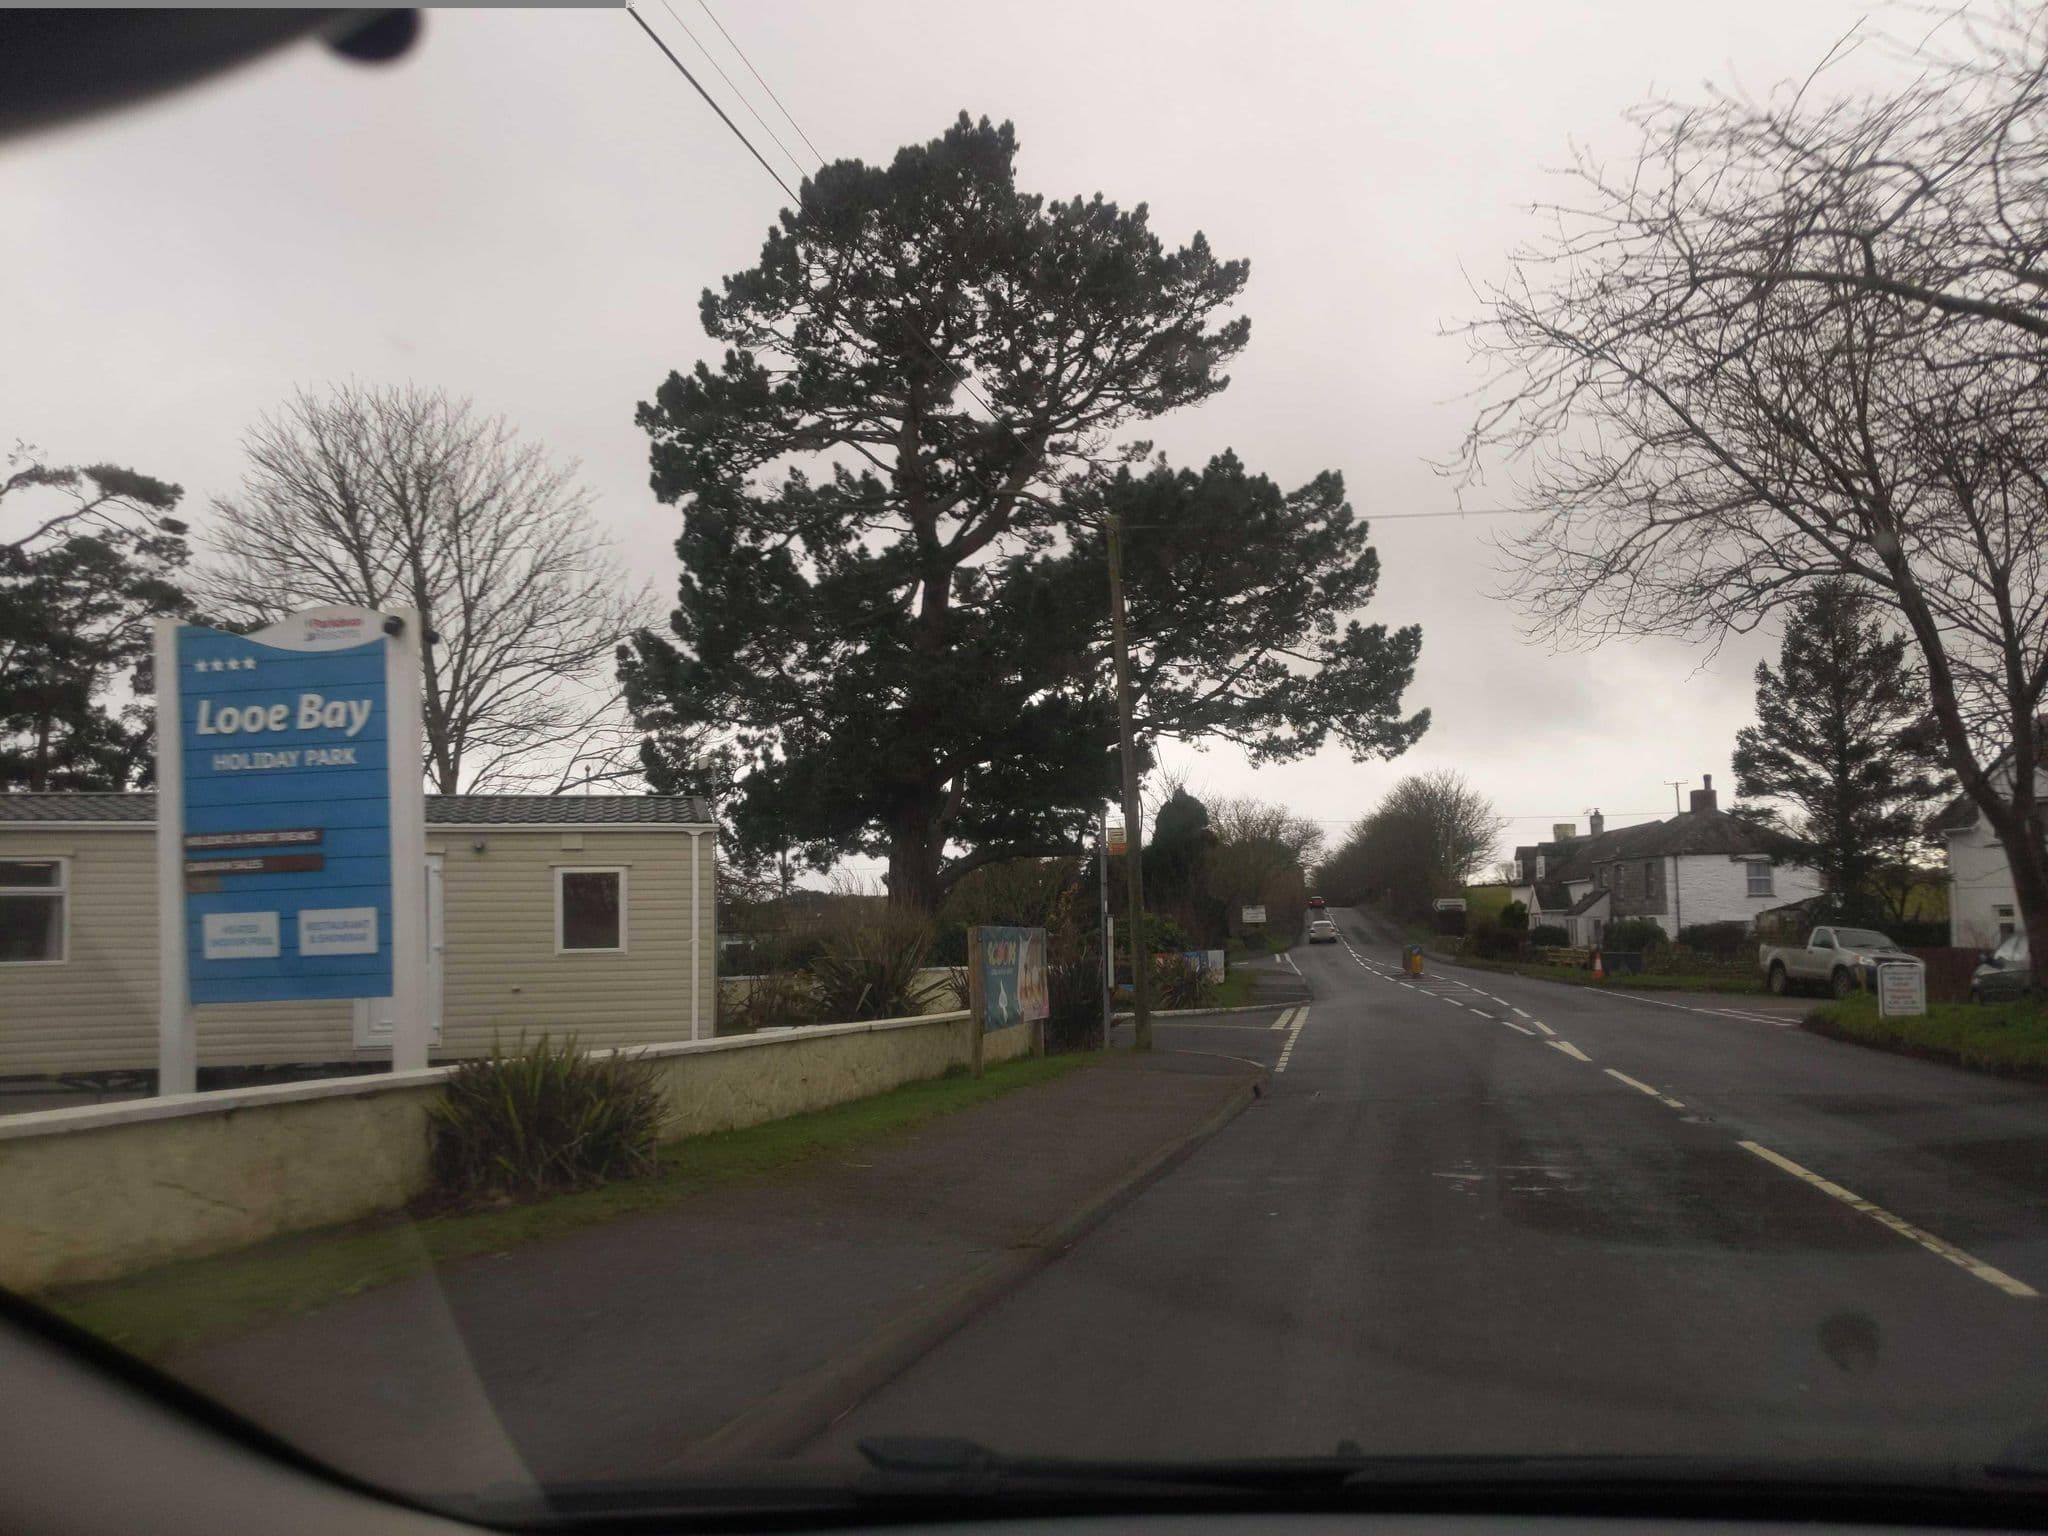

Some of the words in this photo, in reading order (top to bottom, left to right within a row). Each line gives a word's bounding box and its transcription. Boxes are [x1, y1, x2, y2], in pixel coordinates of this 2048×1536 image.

[196, 700, 289, 735] Looe
[297, 693, 373, 737] Bay
[213, 751, 299, 770] HOLIDAY
[304, 748, 357, 766] PARK
